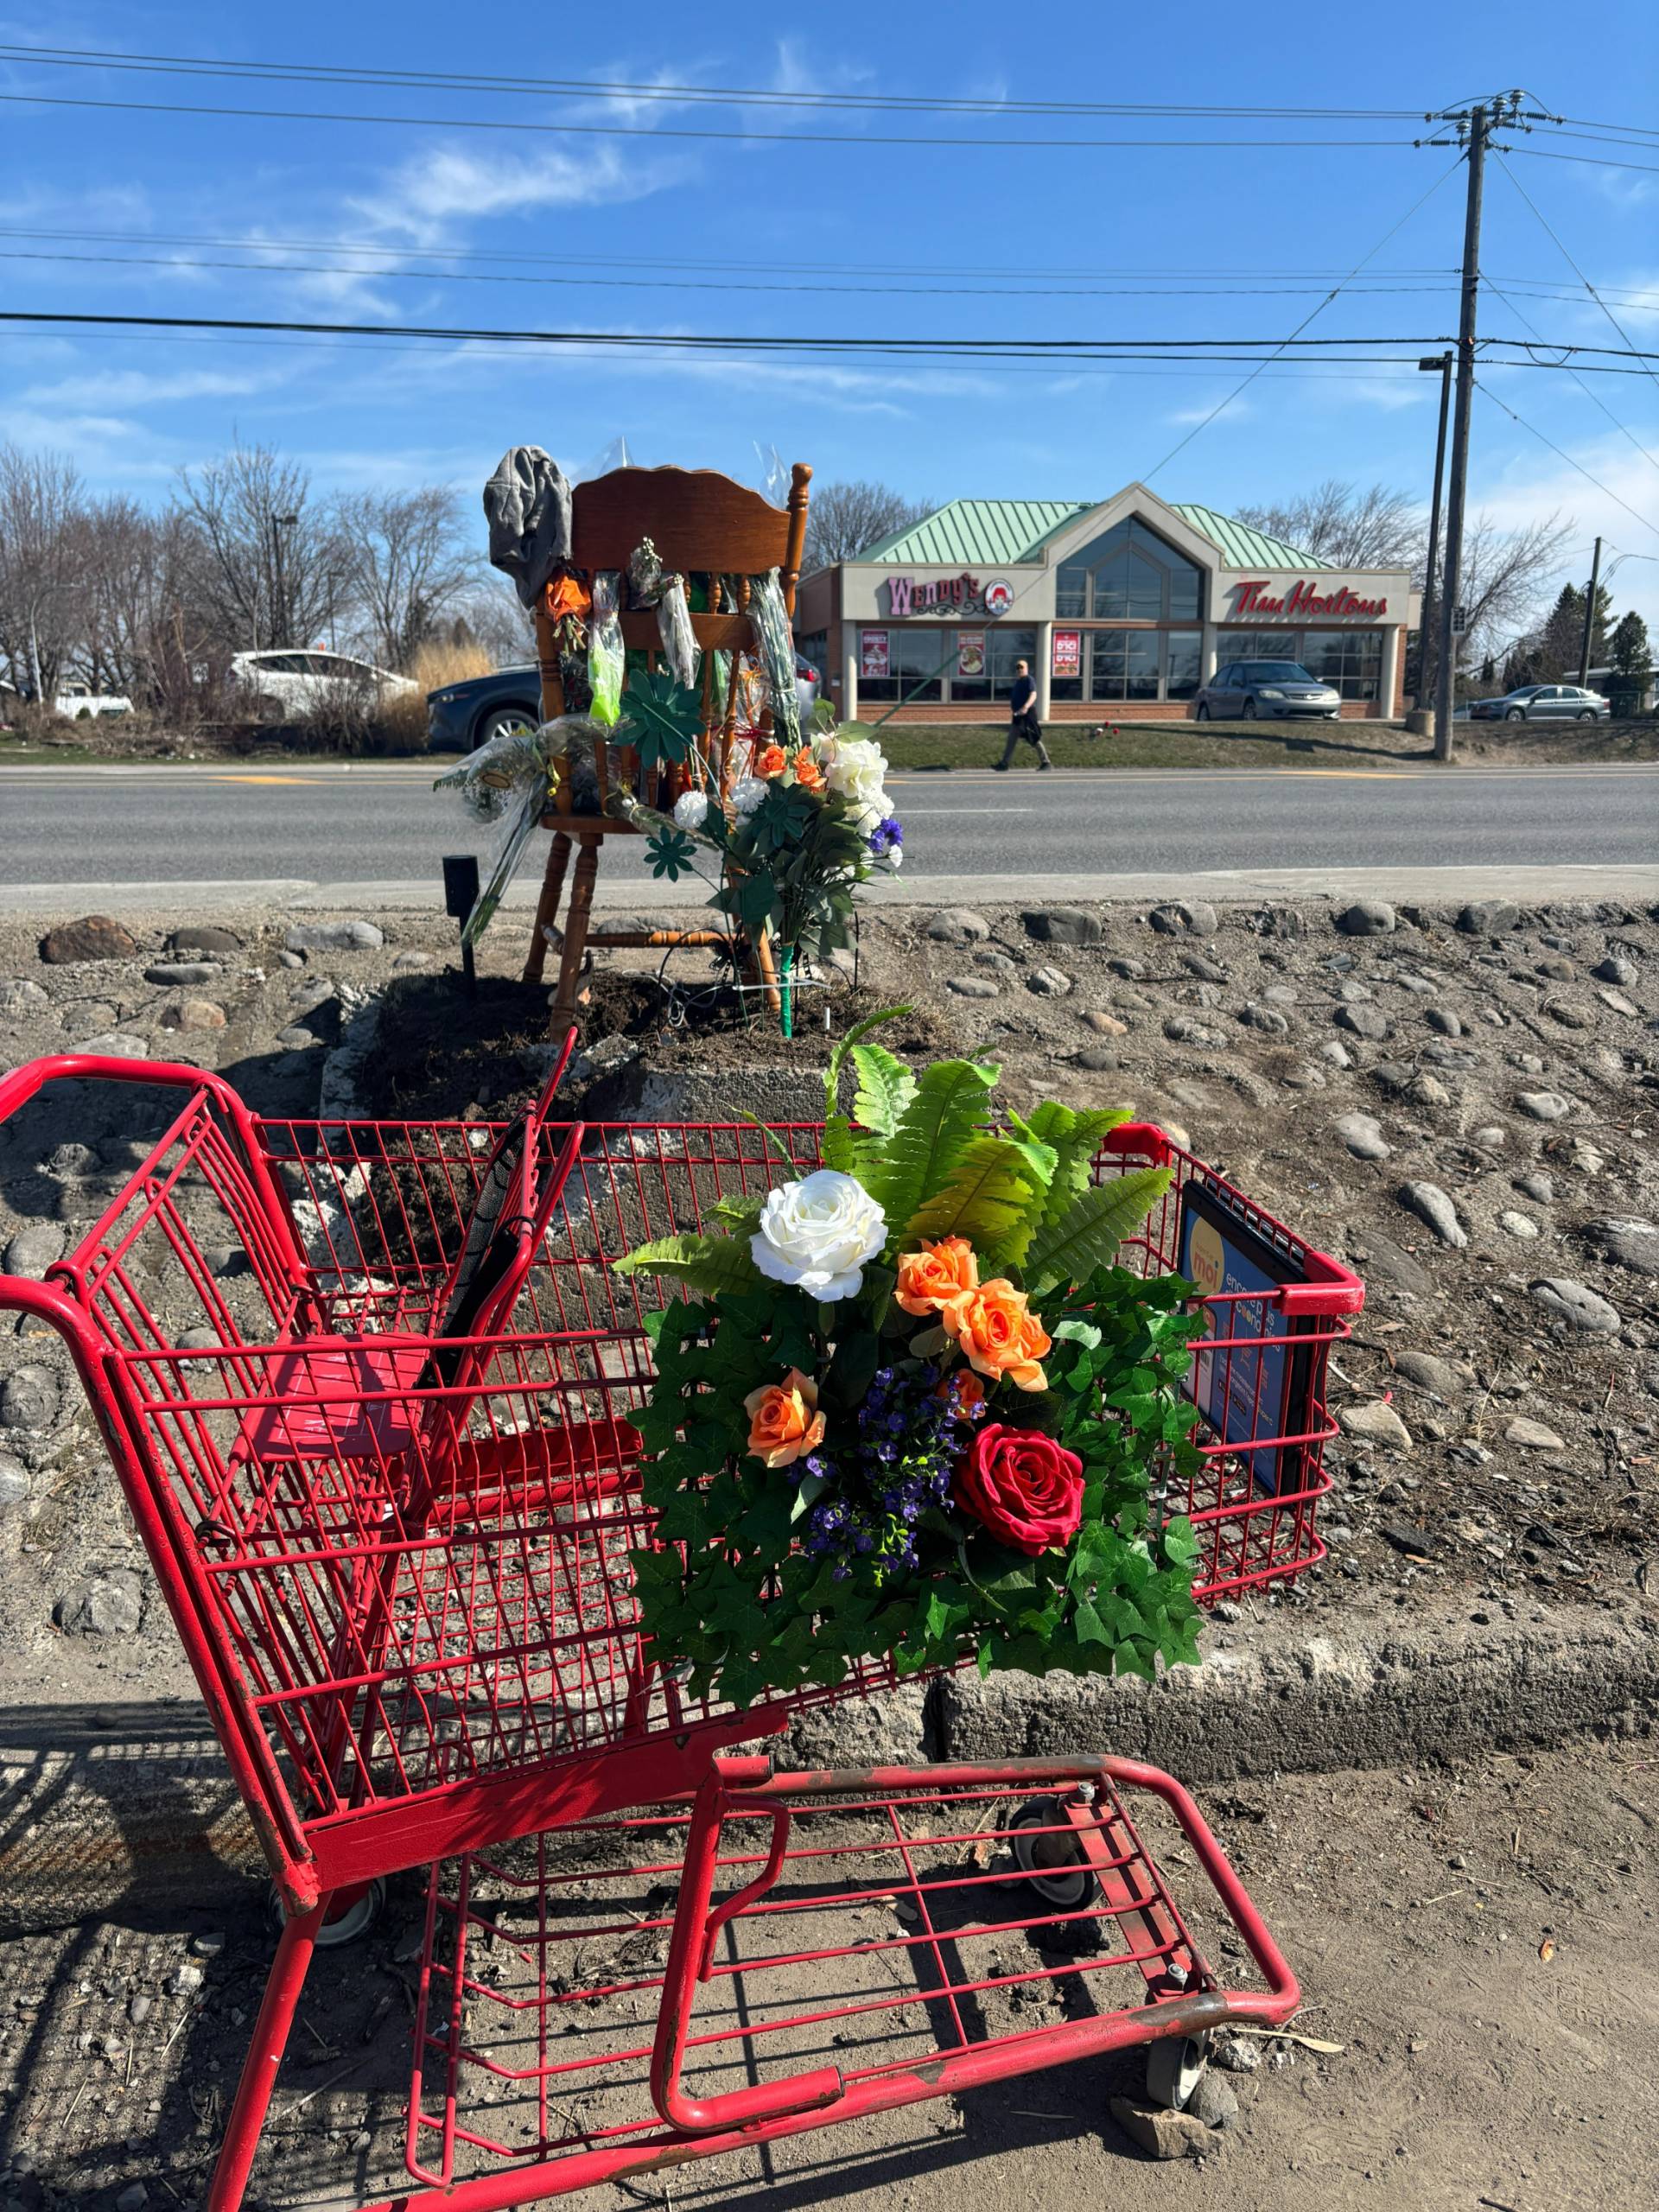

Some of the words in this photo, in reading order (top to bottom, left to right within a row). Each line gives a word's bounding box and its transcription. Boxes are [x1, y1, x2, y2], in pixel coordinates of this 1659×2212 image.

[1236, 581, 1286, 614] Tim
[1288, 580, 1387, 615] Hortons
[1194, 1252, 1218, 1288] moi
[1226, 1273, 1256, 1308] ence
